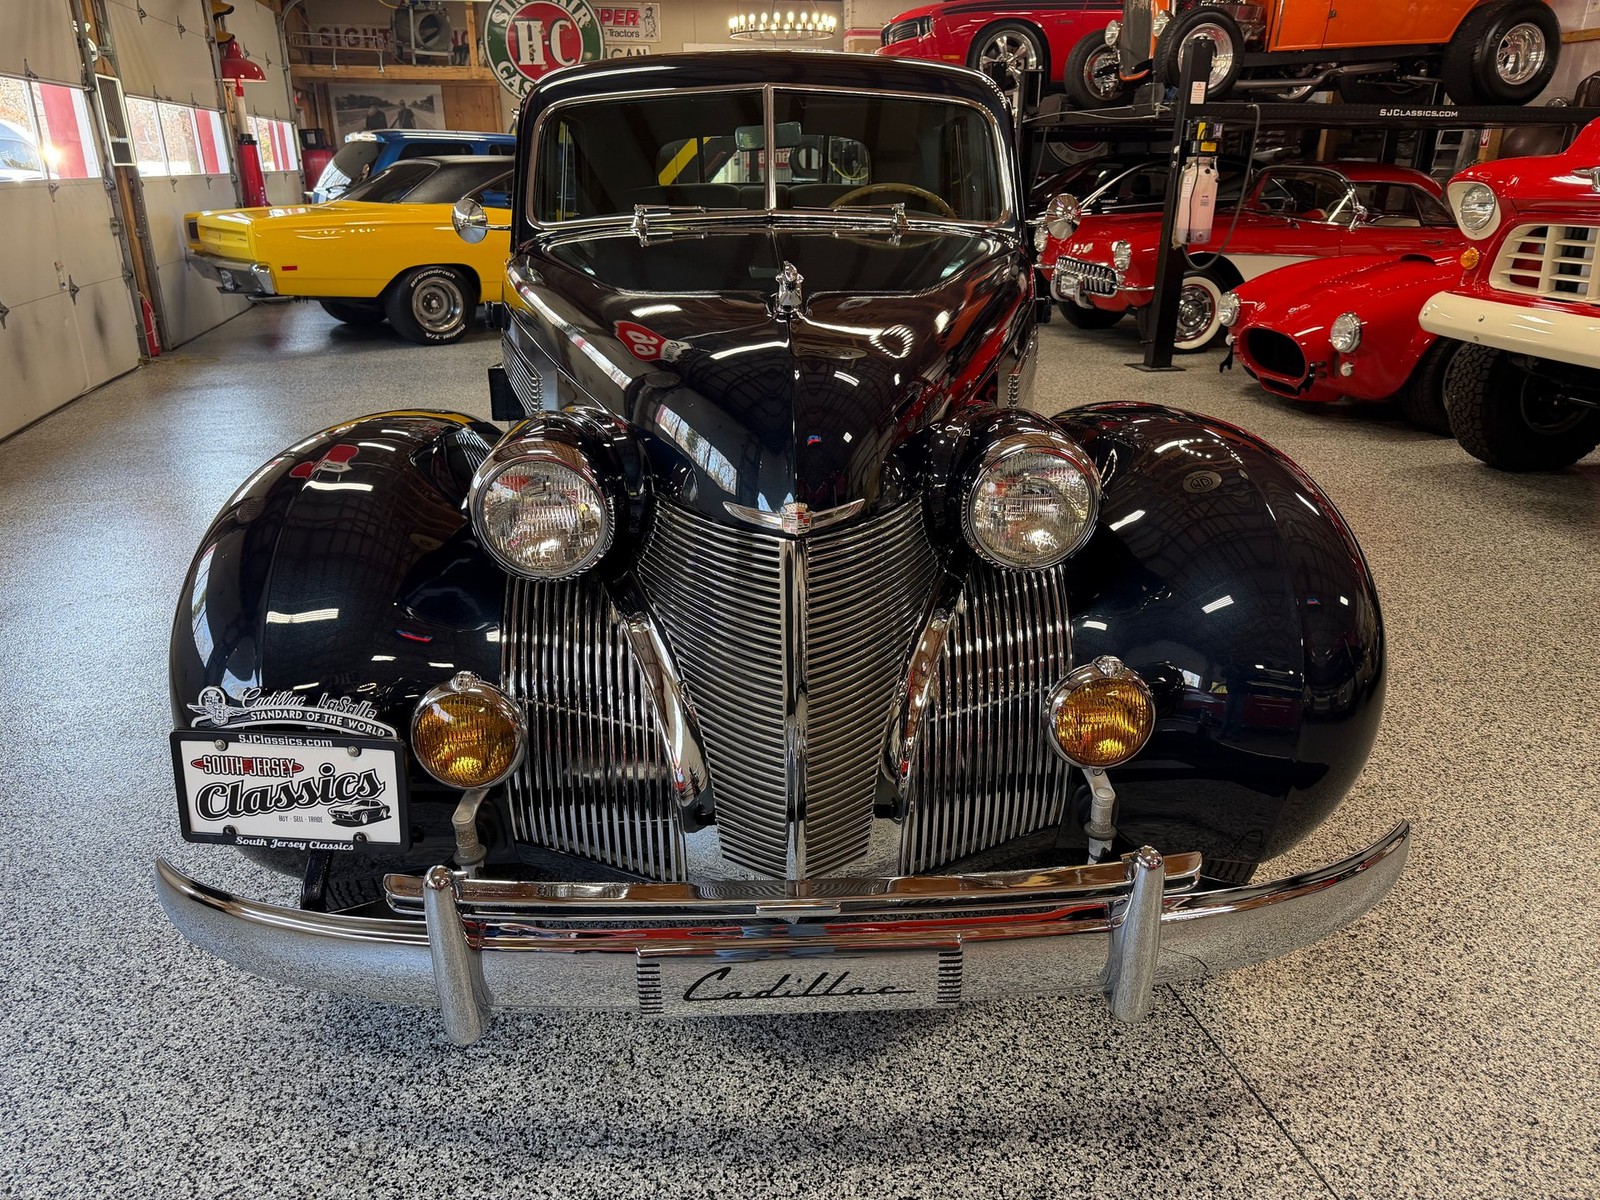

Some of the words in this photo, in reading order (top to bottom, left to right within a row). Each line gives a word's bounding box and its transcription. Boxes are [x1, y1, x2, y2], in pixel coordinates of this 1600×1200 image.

[607, 28, 640, 38] Tractors
[241, 687, 306, 708] Cadillac
[316, 693, 377, 720] LaSalle
[250, 710, 303, 721] STANDARD
[306, 711, 321, 722] OF
[323, 714, 343, 726] THE
[348, 719, 386, 738] WORLD
[238, 734, 333, 748] SJClassics.com
[202, 755, 245, 775] SOUTH
[249, 757, 295, 777] JERSEY
[196, 763, 386, 821] Classics
[278, 814, 289, 823] BUY
[235, 836, 267, 847] South
[269, 839, 307, 851] Jersey
[308, 840, 354, 851] Classics
[683, 966, 916, 1001] Cadillac
